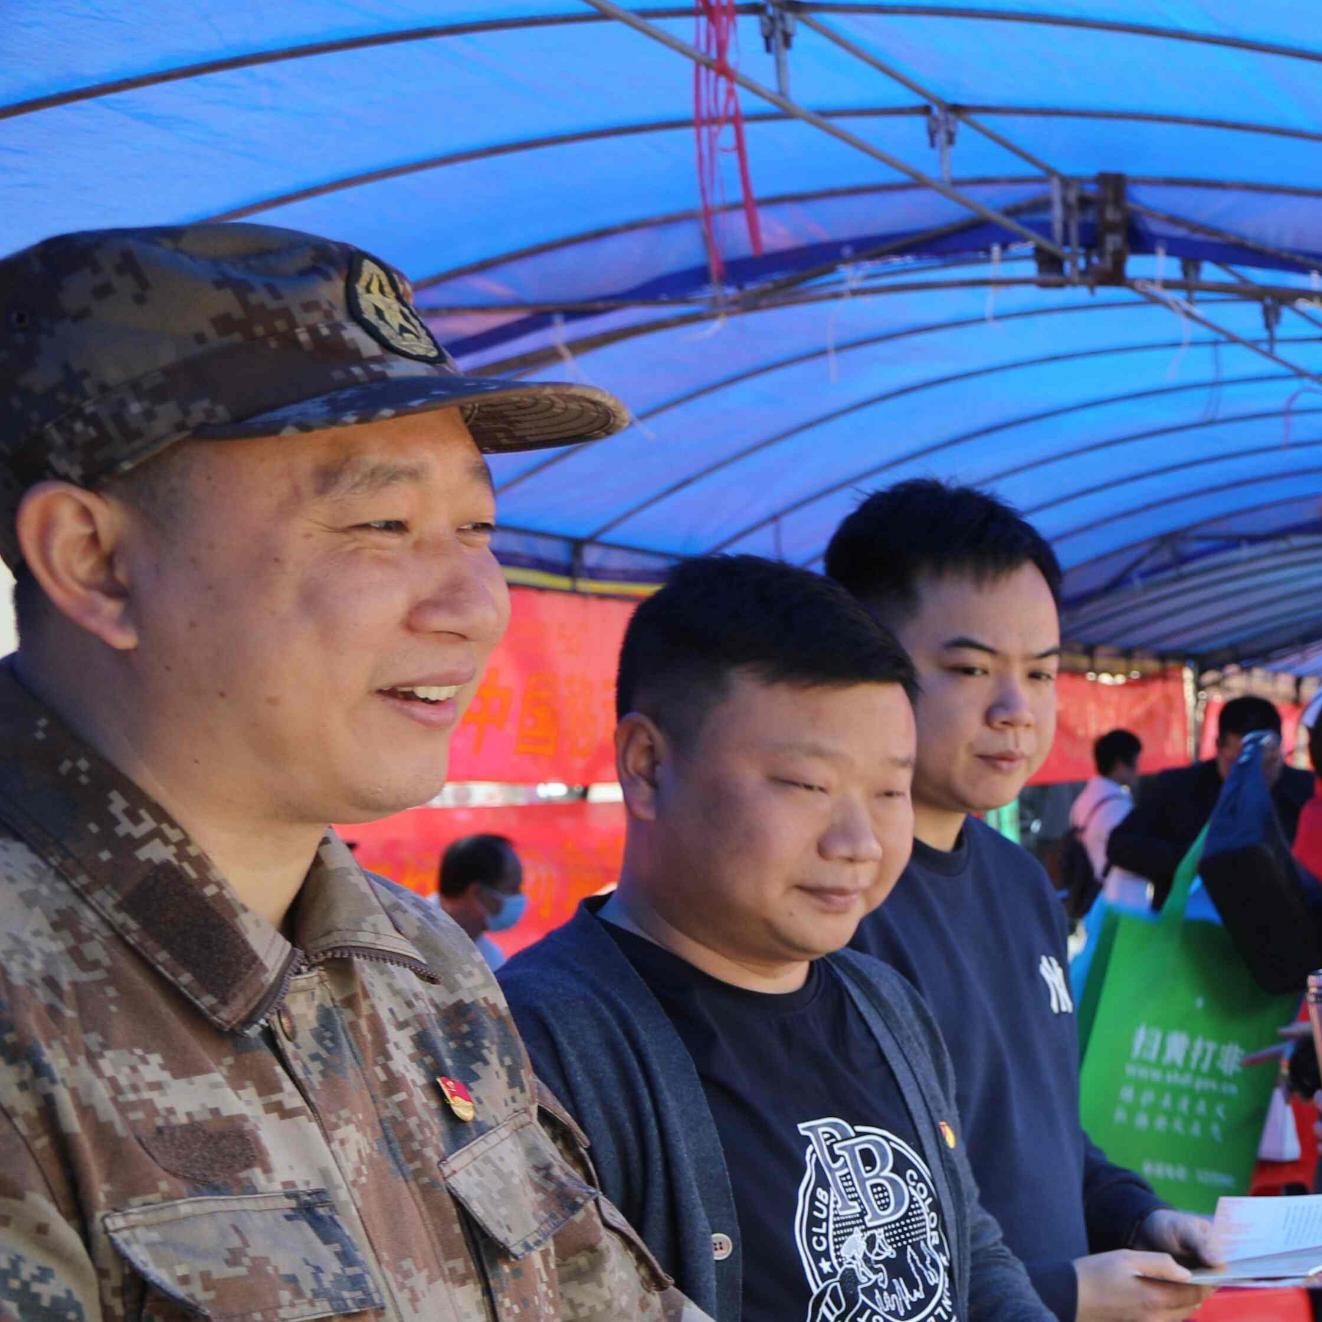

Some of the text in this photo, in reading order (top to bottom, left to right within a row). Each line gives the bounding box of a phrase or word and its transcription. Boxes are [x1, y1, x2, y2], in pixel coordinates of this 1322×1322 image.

[1132, 1024, 1244, 1077] 扫黄打非
[813, 1187, 829, 1252] CLUB
[906, 1170, 940, 1252] COLOR
